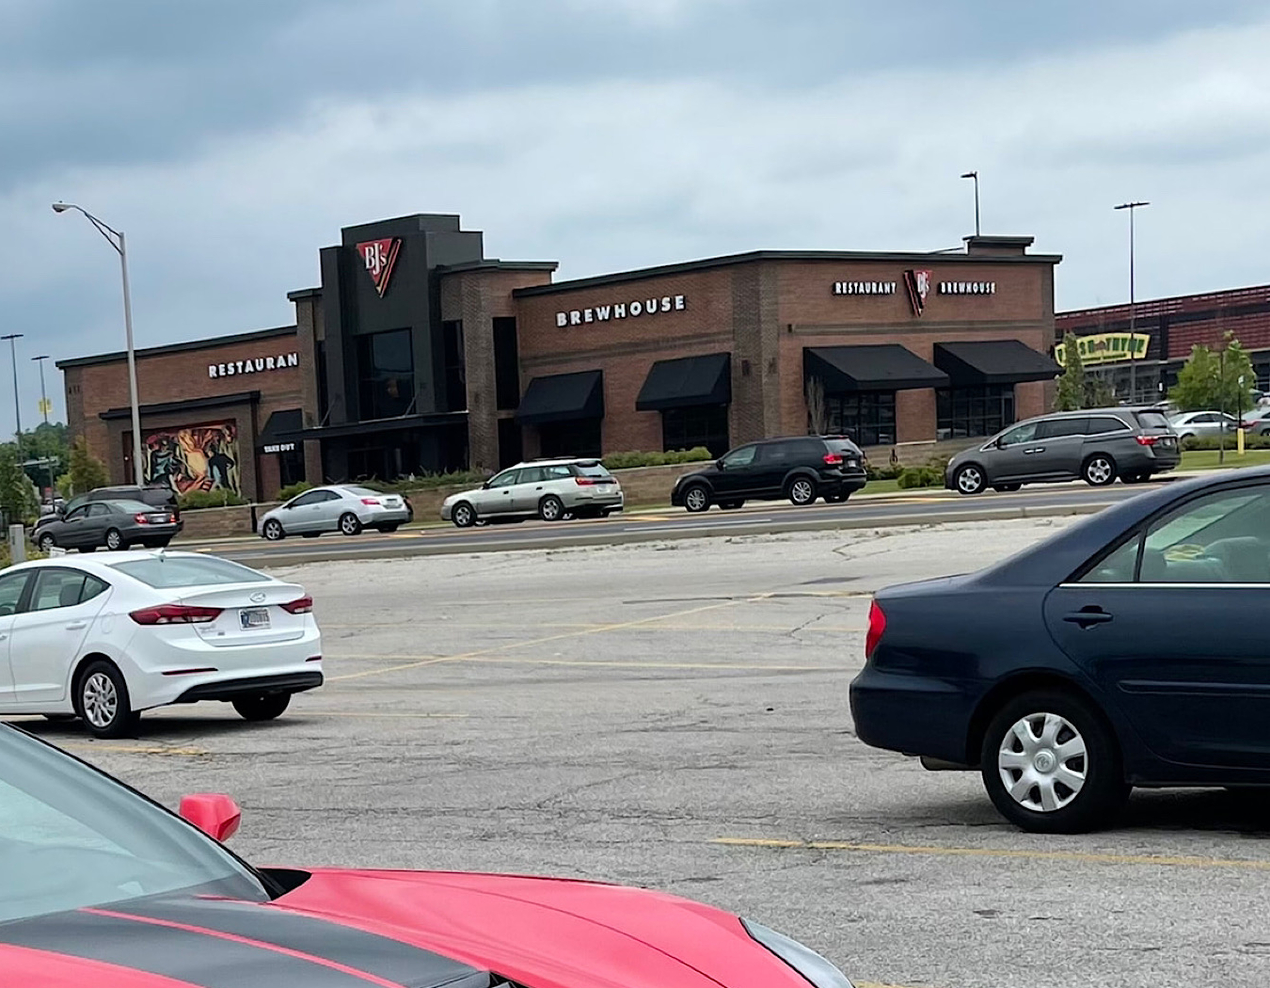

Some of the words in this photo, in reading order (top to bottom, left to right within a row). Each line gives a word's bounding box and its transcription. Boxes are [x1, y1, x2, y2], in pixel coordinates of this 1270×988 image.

[364, 242, 387, 275] BJ's
[835, 281, 898, 295] RESTAURANT
[940, 281, 997, 294] BREWHOUSE
[556, 295, 685, 327] BREWHOUSE
[208, 352, 298, 378] RESTAURAN
[280, 443, 295, 452] OUT
